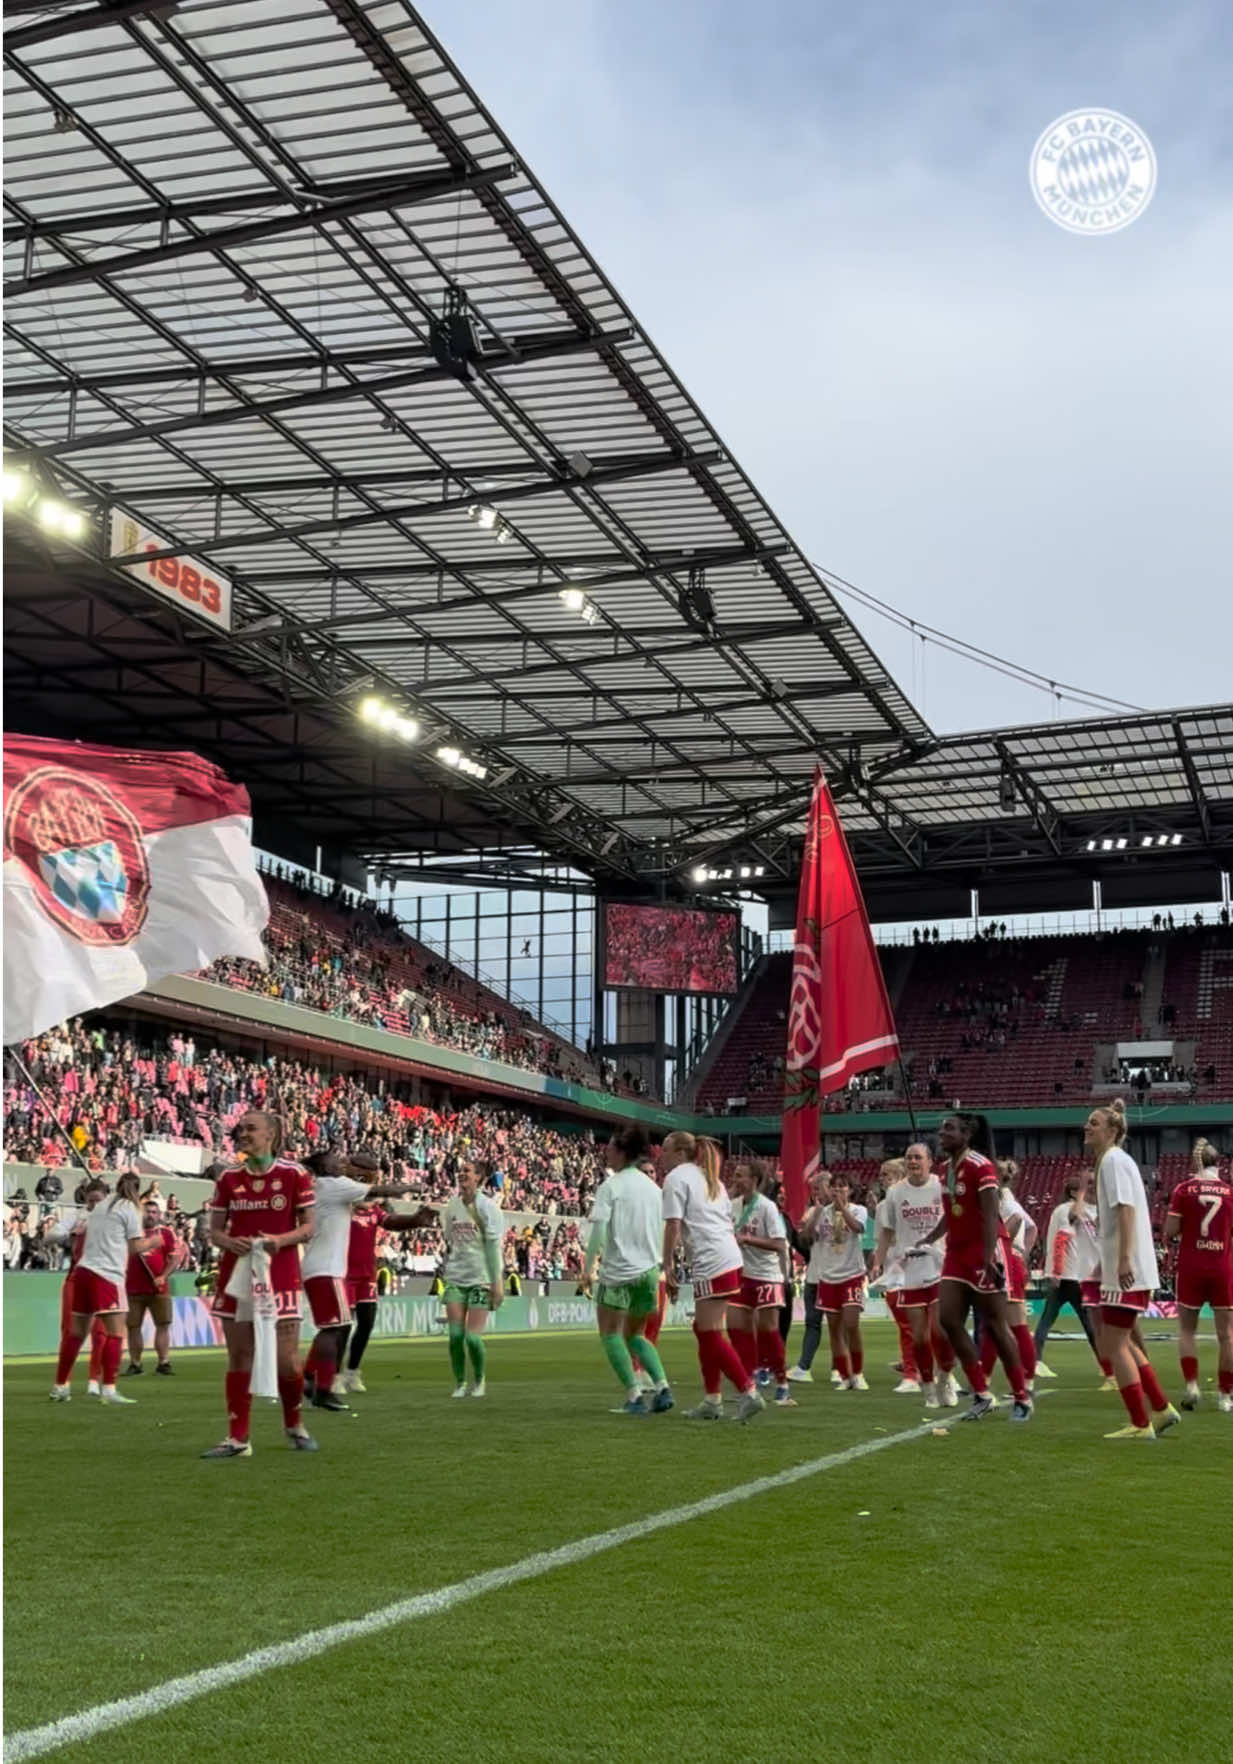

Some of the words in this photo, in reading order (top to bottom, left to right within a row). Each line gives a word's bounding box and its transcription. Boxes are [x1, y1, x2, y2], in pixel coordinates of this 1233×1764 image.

[146, 543, 222, 615] 1983
[229, 1199, 269, 1211] Allianz
[1198, 1194, 1222, 1238] 7
[757, 1284, 773, 1303] 27
[847, 1287, 862, 1302] 18
